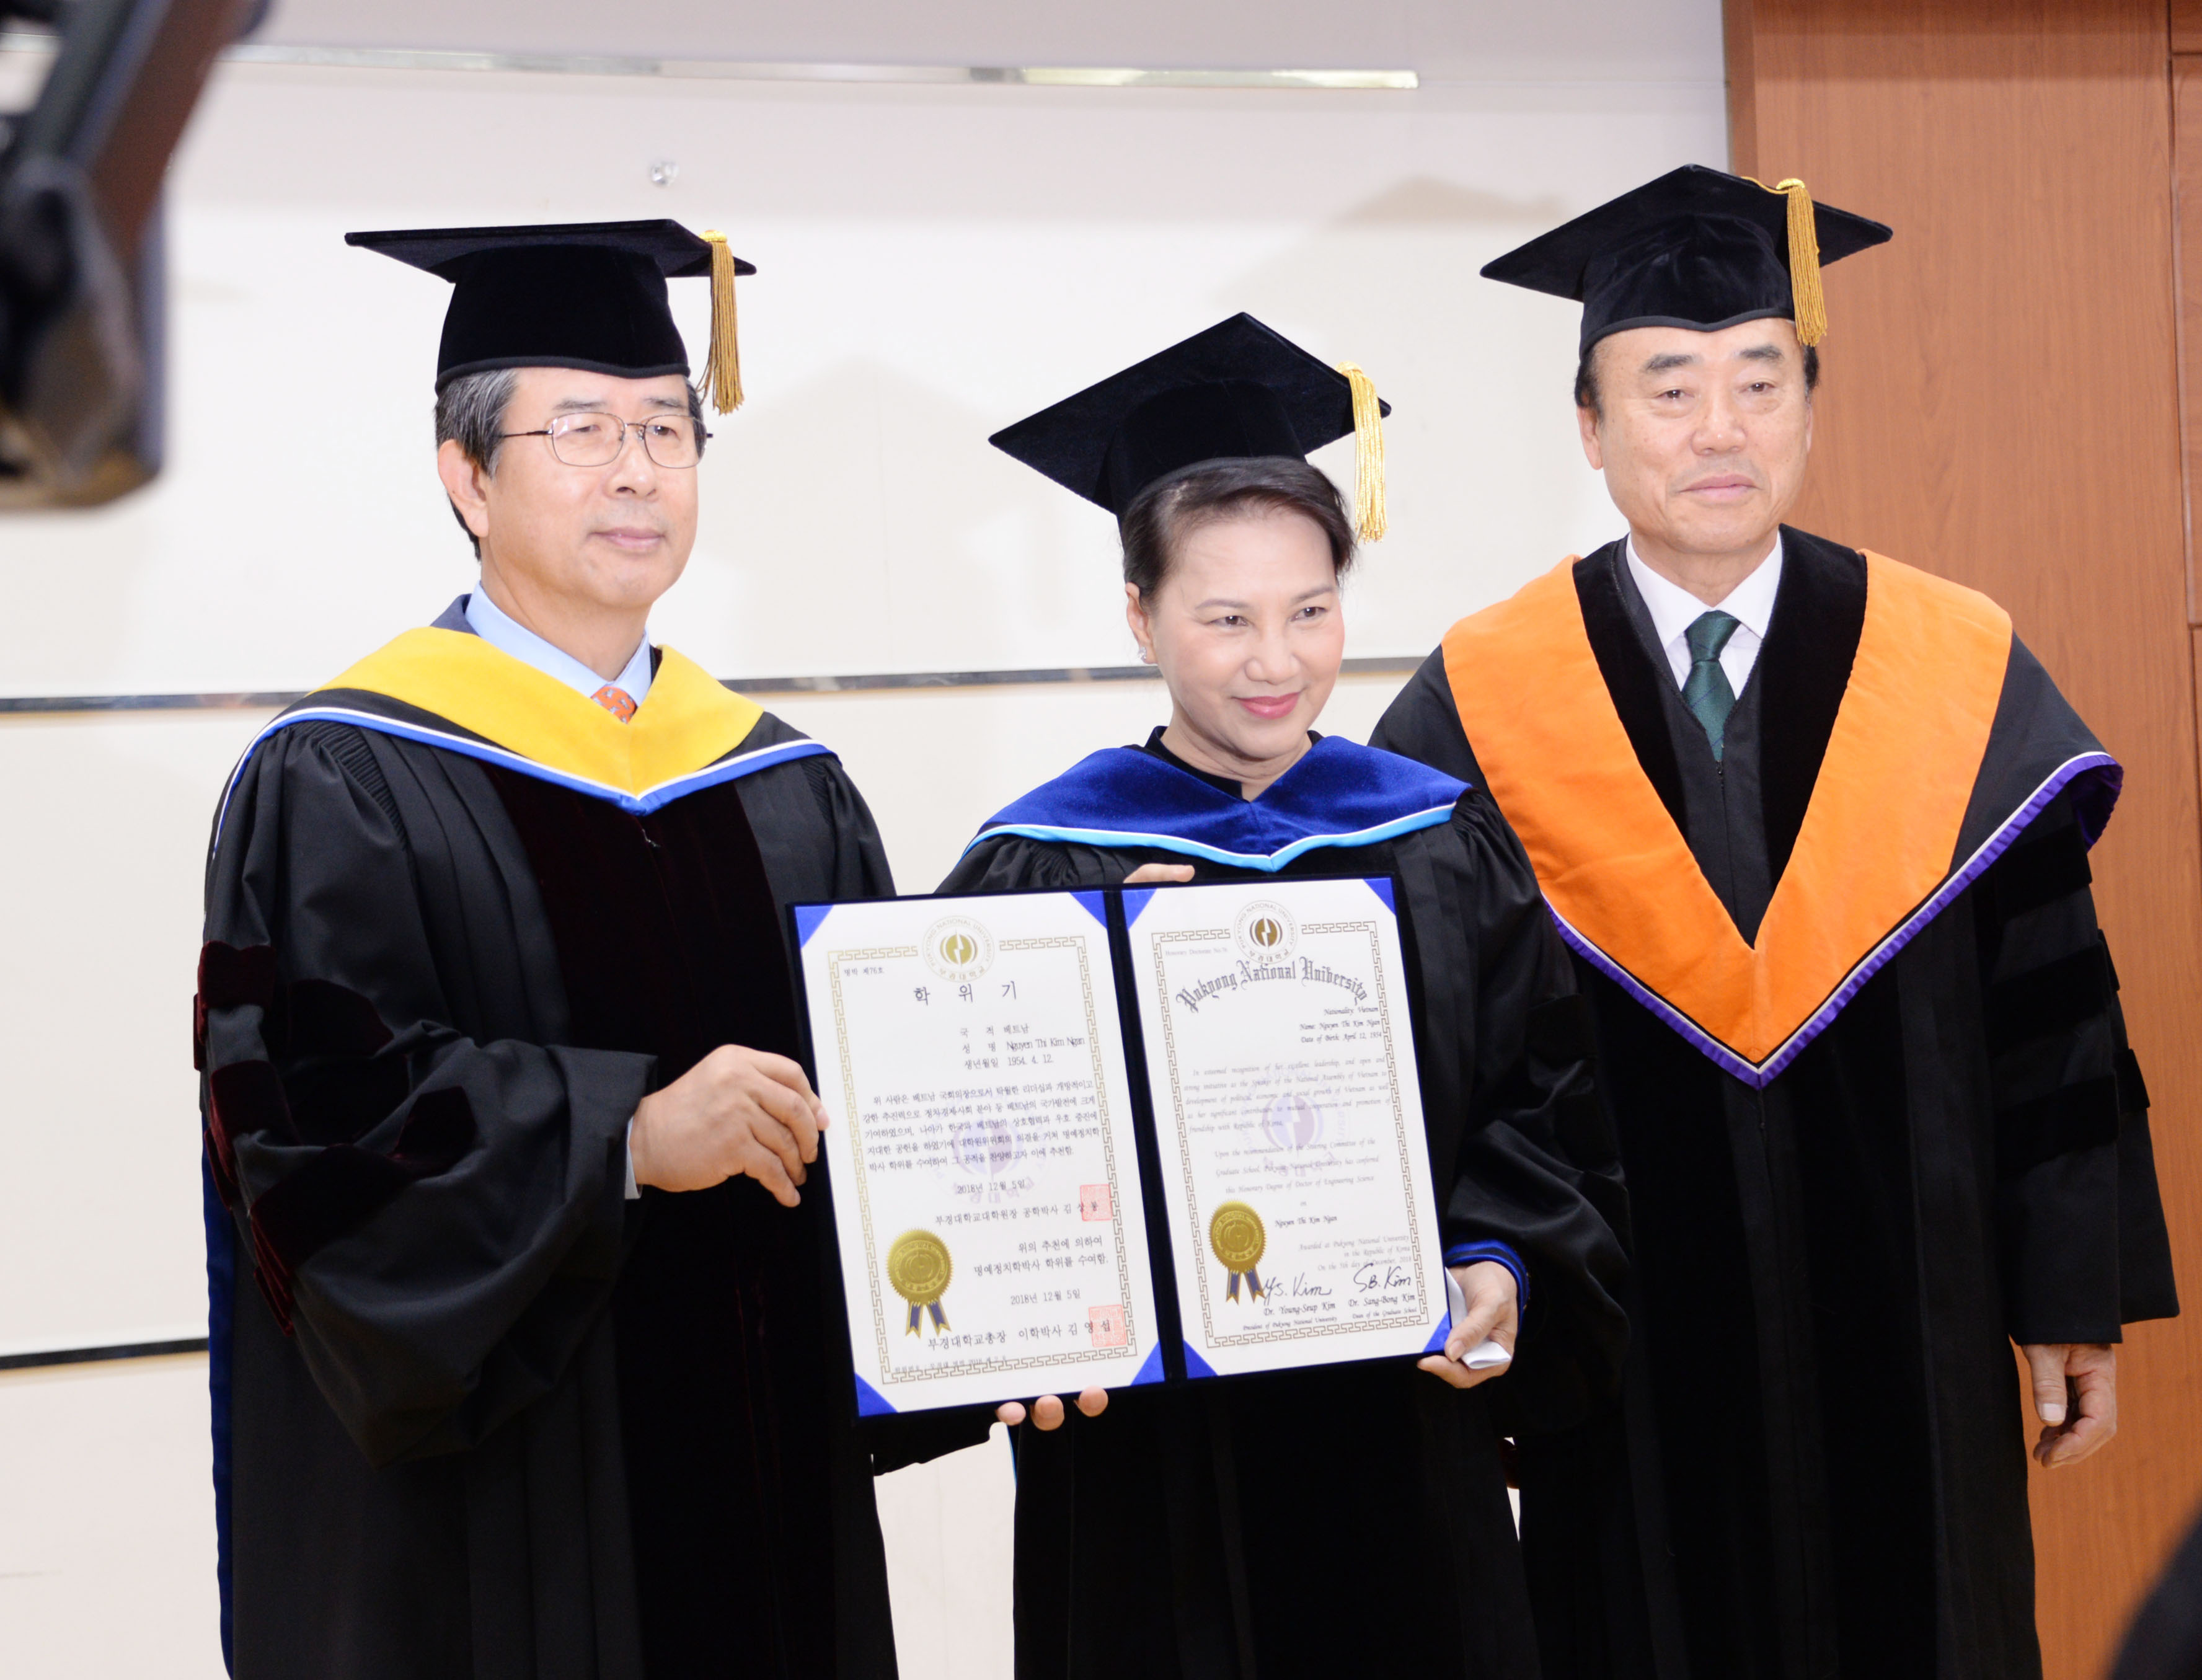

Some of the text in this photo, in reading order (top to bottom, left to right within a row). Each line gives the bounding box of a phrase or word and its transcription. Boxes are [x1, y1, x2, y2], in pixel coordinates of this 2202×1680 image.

[1236, 960, 1296, 991] National
[1299, 956, 1368, 1006] University
[914, 981, 1017, 1006] 학 위 기
[960, 1028, 969, 1038] 국
[1004, 1024, 1029, 1035] 베트남
[962, 1037, 1085, 1054] 성 명 Nguyen Thi Kim Ngan
[965, 1058, 999, 1070] 생년월일
[874, 1096, 881, 1105] 위
[913, 1092, 935, 1102] 베트남
[957, 1183, 983, 1194] 2018년
[989, 1180, 1007, 1191] 12월
[935, 1208, 1018, 1226] 부경대학교대학원장
[1023, 1205, 1058, 1218] 공학박사
[1064, 1203, 1071, 1214] 김
[1019, 1235, 1102, 1254] 위의 추천에 의하여
[1046, 1256, 1073, 1268] 학위를
[1010, 1288, 1081, 1305] 2018년 12월 5일
[1348, 1299, 1359, 1307] Dr.
[1402, 1293, 1415, 1302] Kim
[1322, 1302, 1335, 1311] Kim
[928, 1330, 1007, 1350] 부경대학교총장
[1019, 1324, 1062, 1340] 이학박사
[1068, 1322, 1077, 1335] 김
